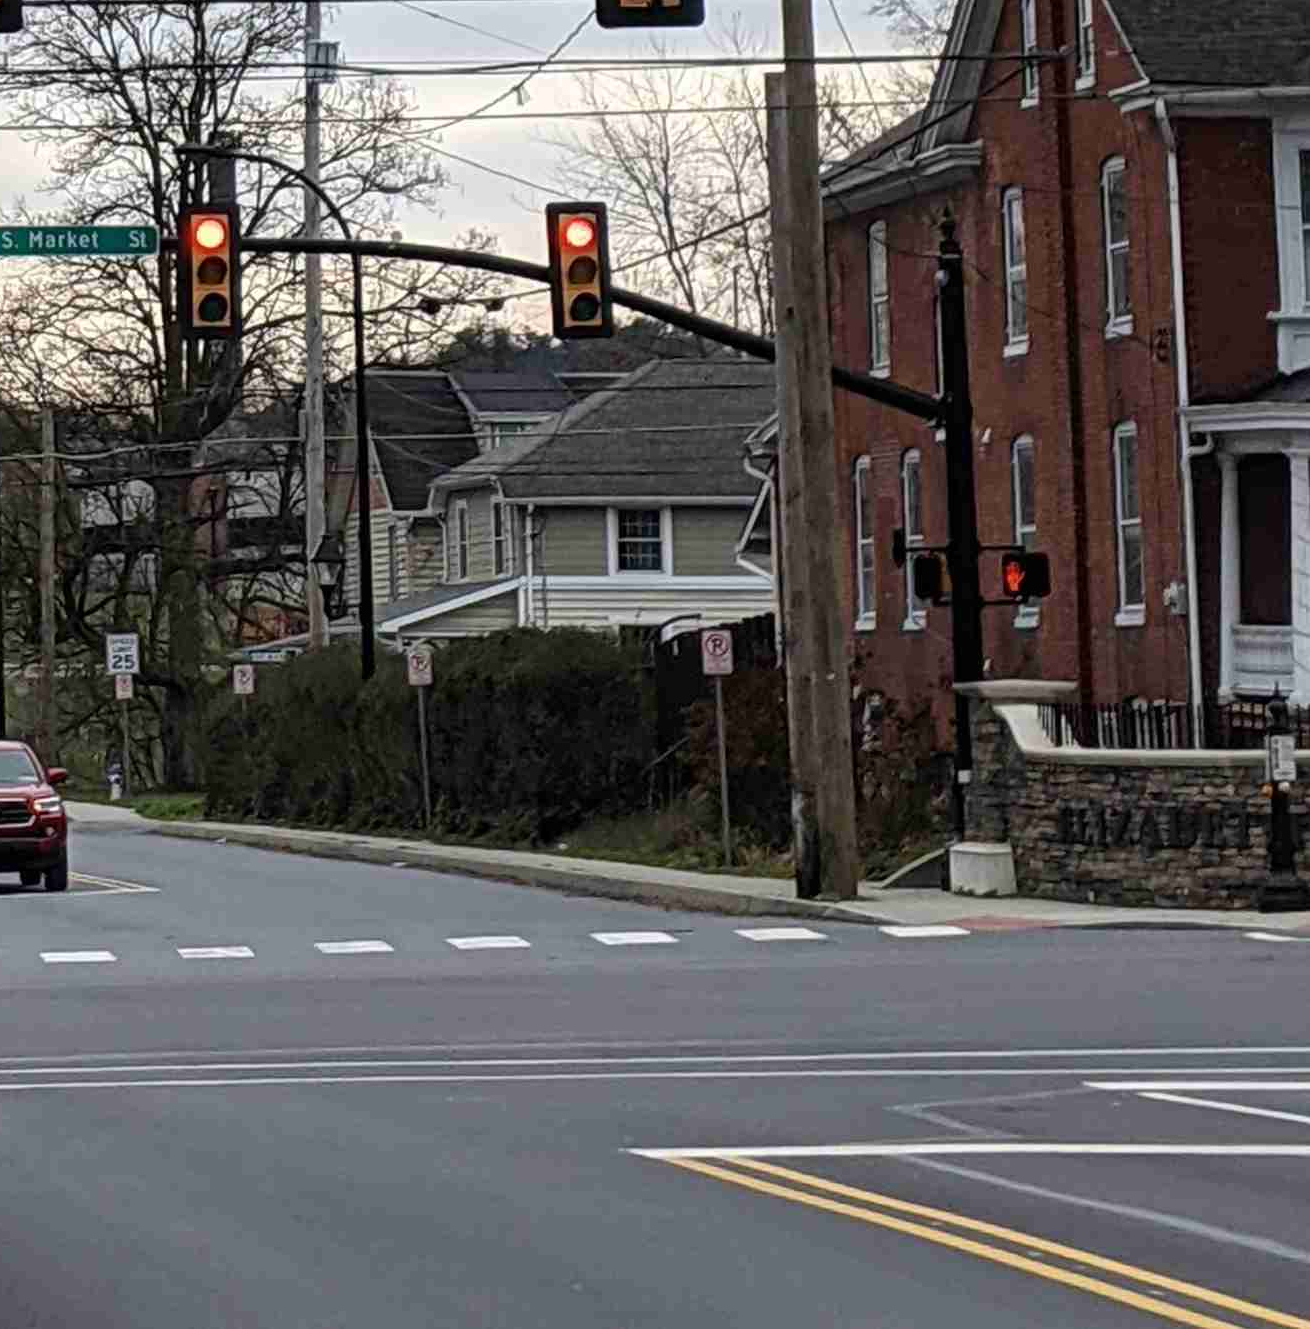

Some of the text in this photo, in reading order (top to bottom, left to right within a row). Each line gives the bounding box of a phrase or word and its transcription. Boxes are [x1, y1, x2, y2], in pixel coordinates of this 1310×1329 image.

[1, 230, 148, 249] S. Market St
[112, 654, 135, 670] 25
